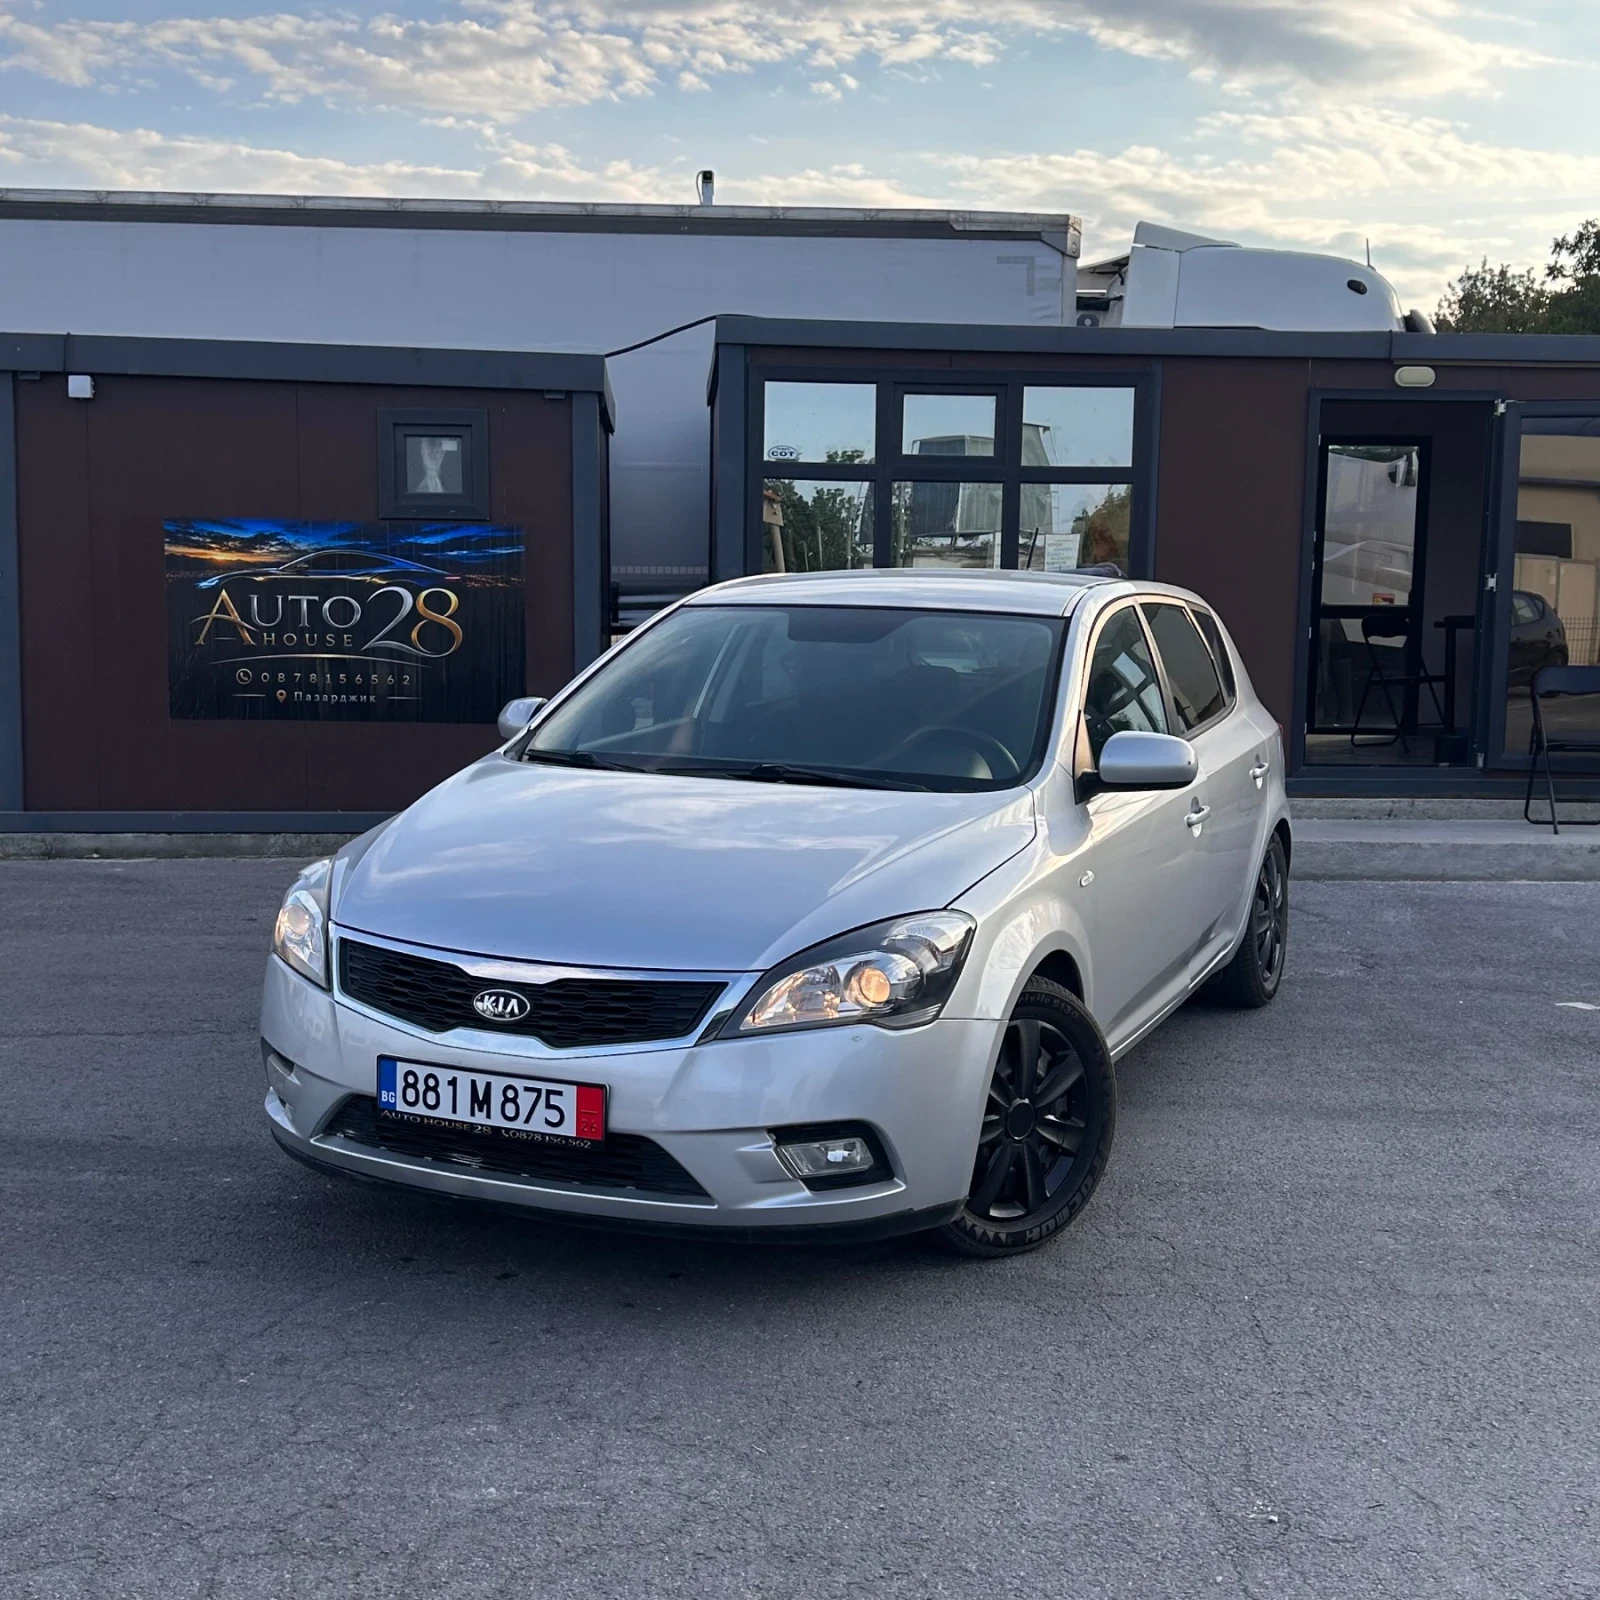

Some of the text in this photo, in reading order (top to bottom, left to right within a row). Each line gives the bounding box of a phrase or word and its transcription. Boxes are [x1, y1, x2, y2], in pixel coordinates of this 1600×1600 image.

[361, 586, 463, 658] 28
[263, 632, 353, 647] HOUSE
[293, 691, 376, 704] Пазарджик
[483, 994, 519, 1016] KIA
[381, 1090, 396, 1103] BG
[381, 1110, 591, 1149] AUTO HOUSE 28 0878 156 562
